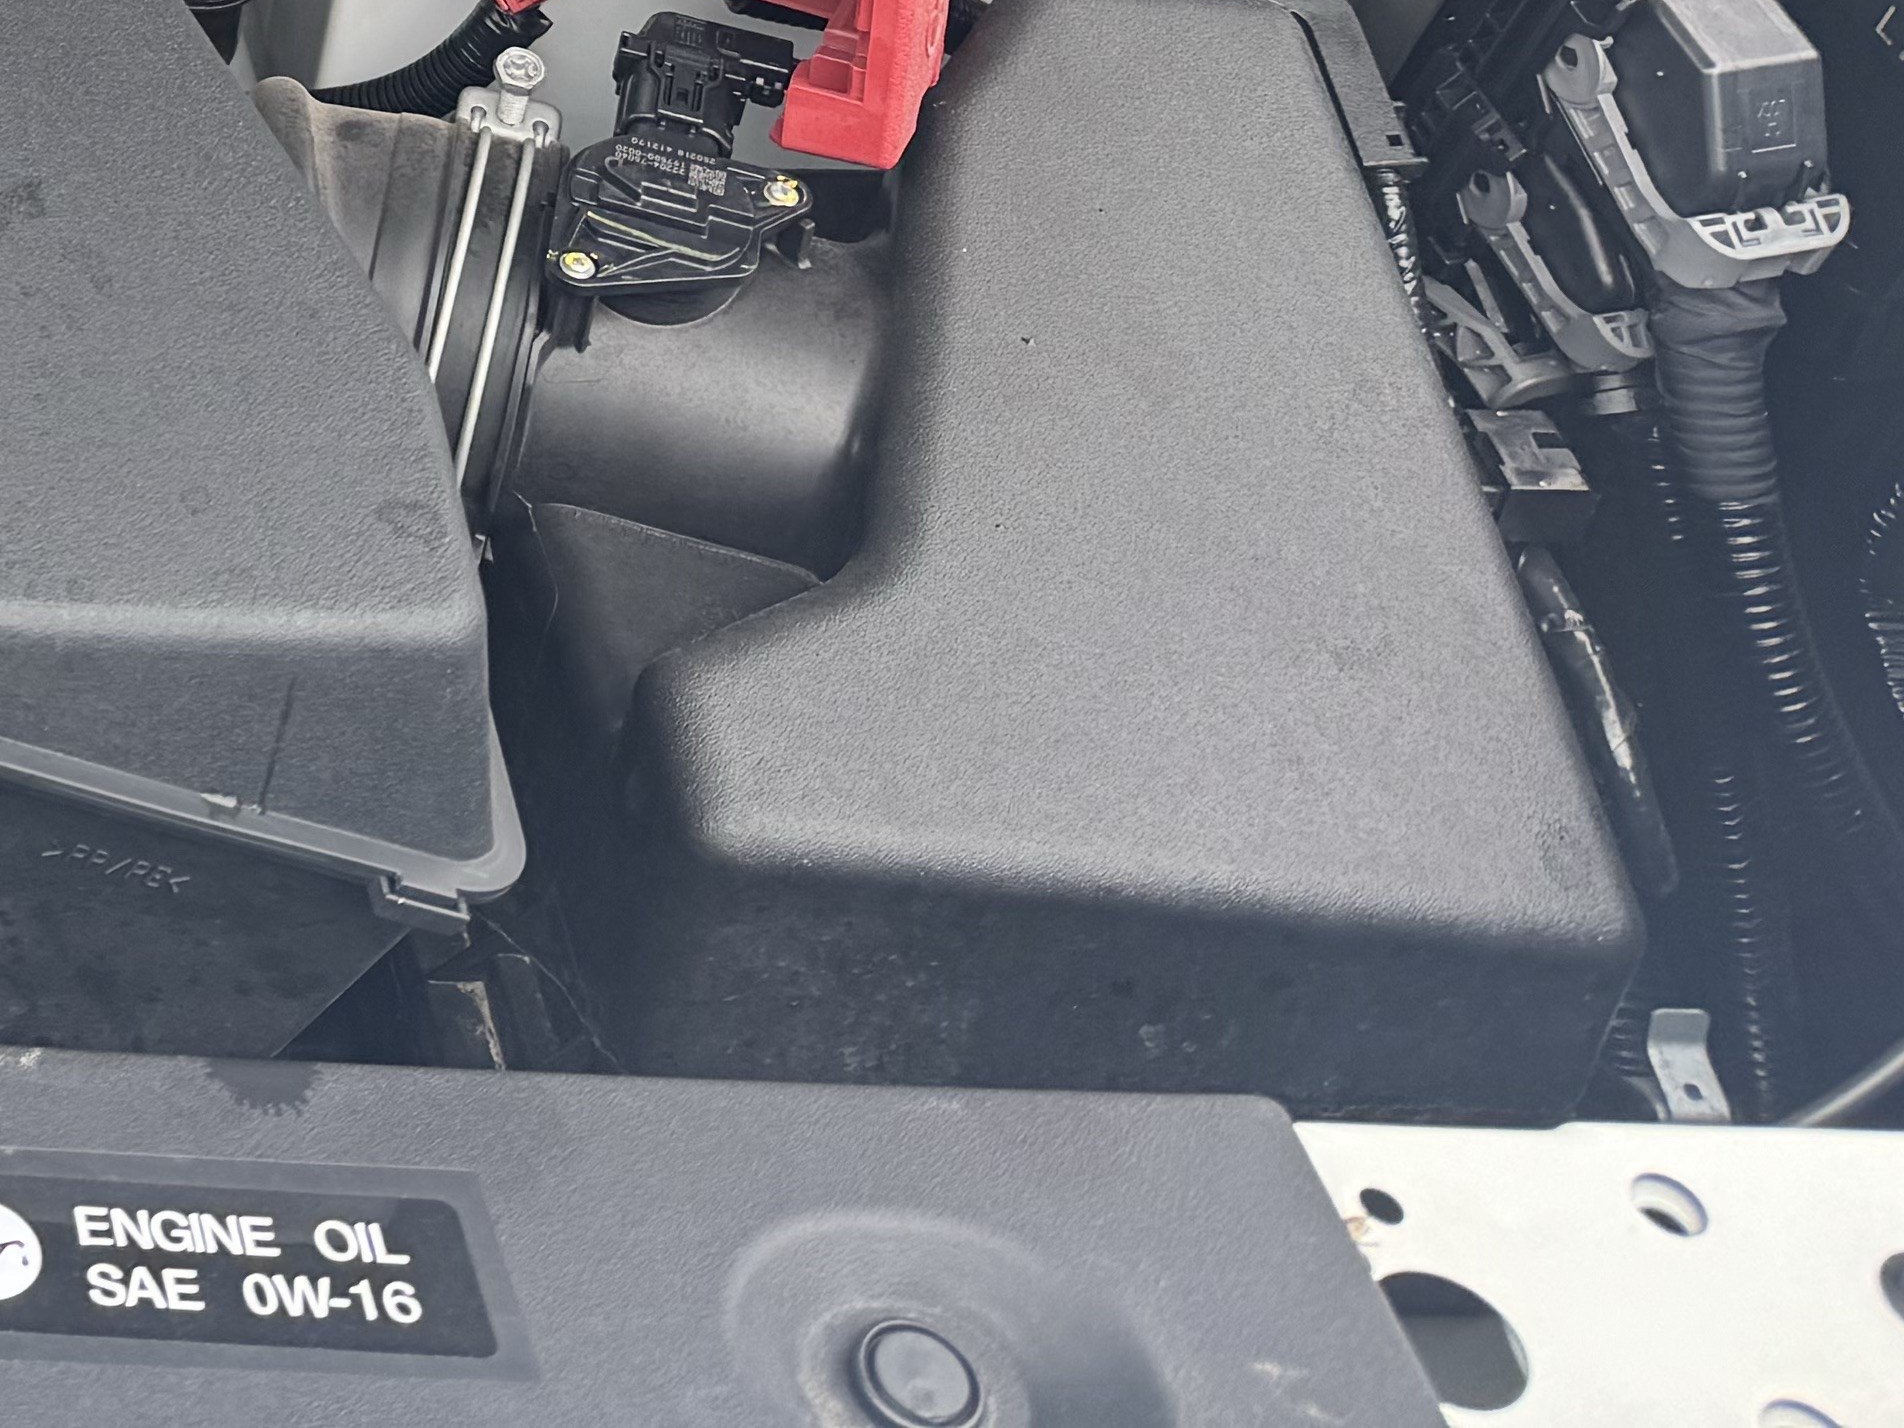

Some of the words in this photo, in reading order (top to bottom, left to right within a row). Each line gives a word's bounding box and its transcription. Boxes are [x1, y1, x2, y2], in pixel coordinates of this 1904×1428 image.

[72, 1205, 282, 1260] ENGINE
[312, 1219, 411, 1268] OIL
[85, 1262, 204, 1315] SAE
[241, 1274, 423, 1326] 0W-16
